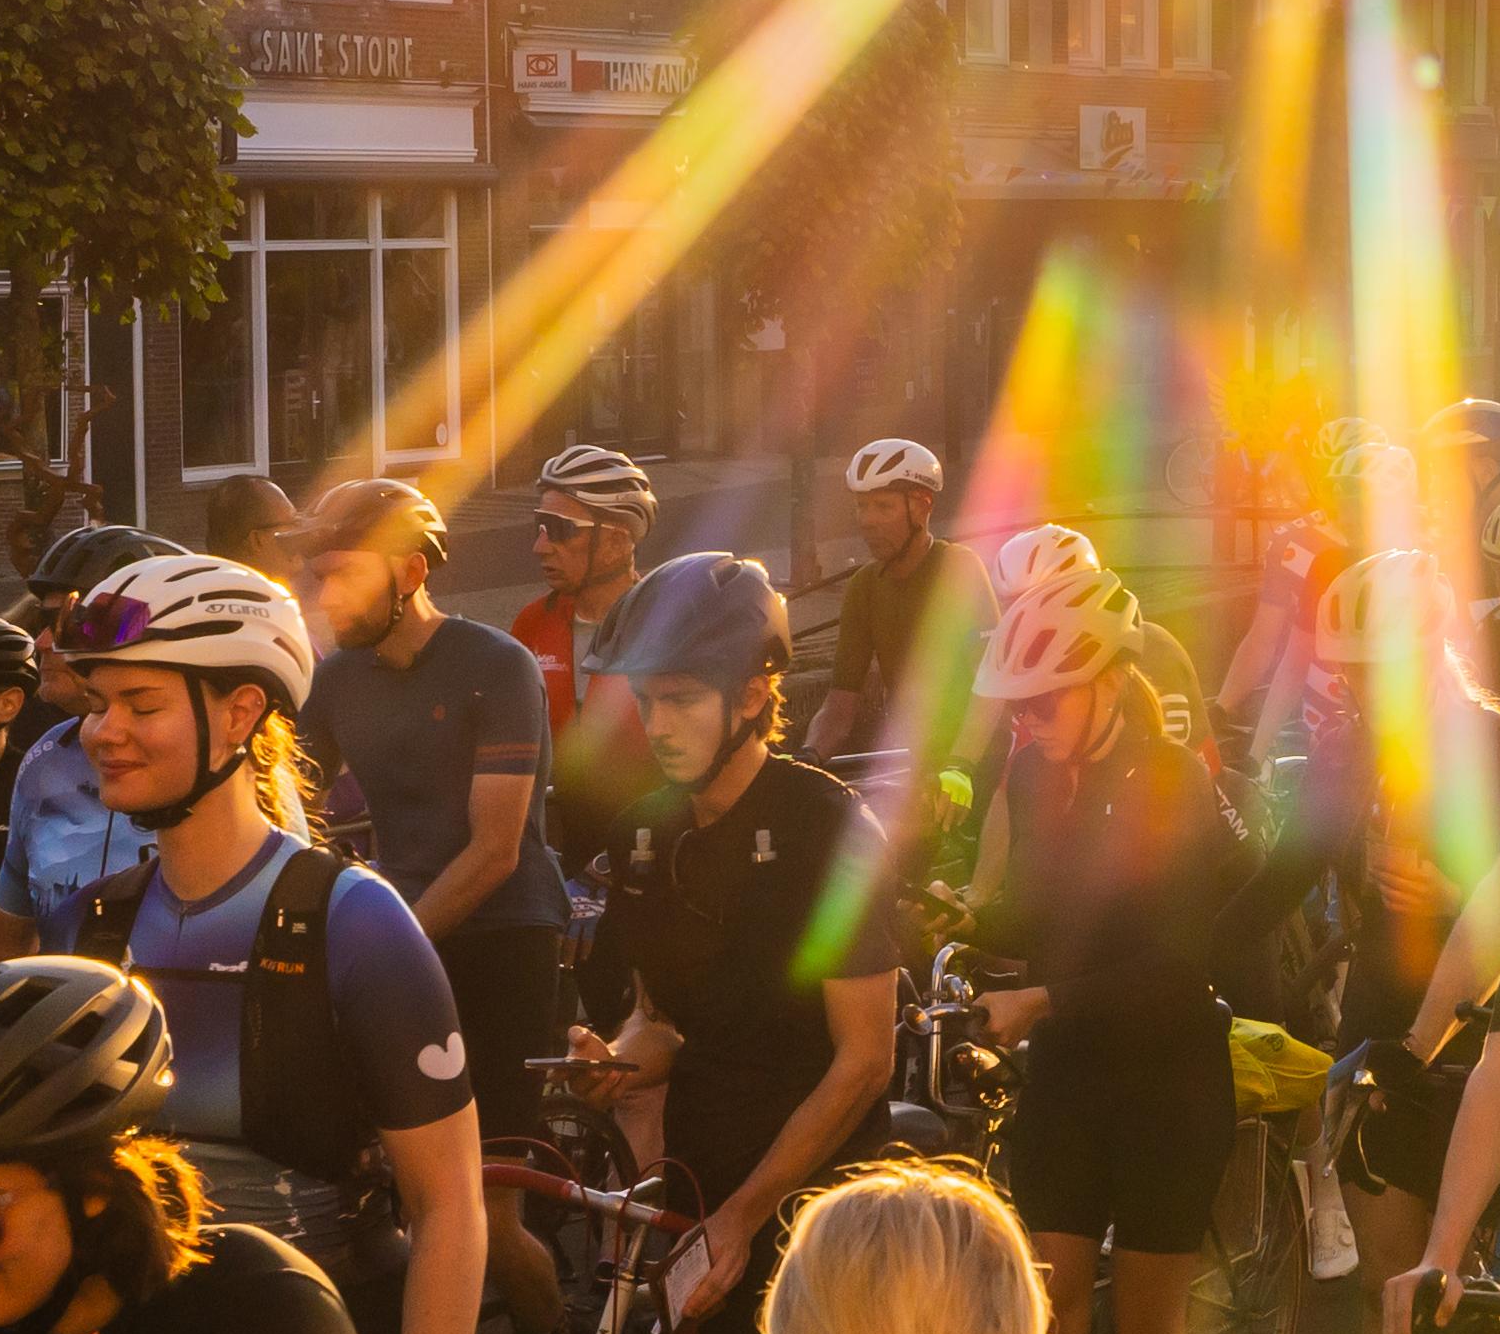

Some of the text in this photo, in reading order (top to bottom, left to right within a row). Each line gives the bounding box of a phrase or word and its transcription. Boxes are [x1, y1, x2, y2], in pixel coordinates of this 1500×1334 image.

[262, 29, 413, 78] SAKE STORE
[610, 61, 653, 92] HANS
[229, 603, 270, 618] GIRO
